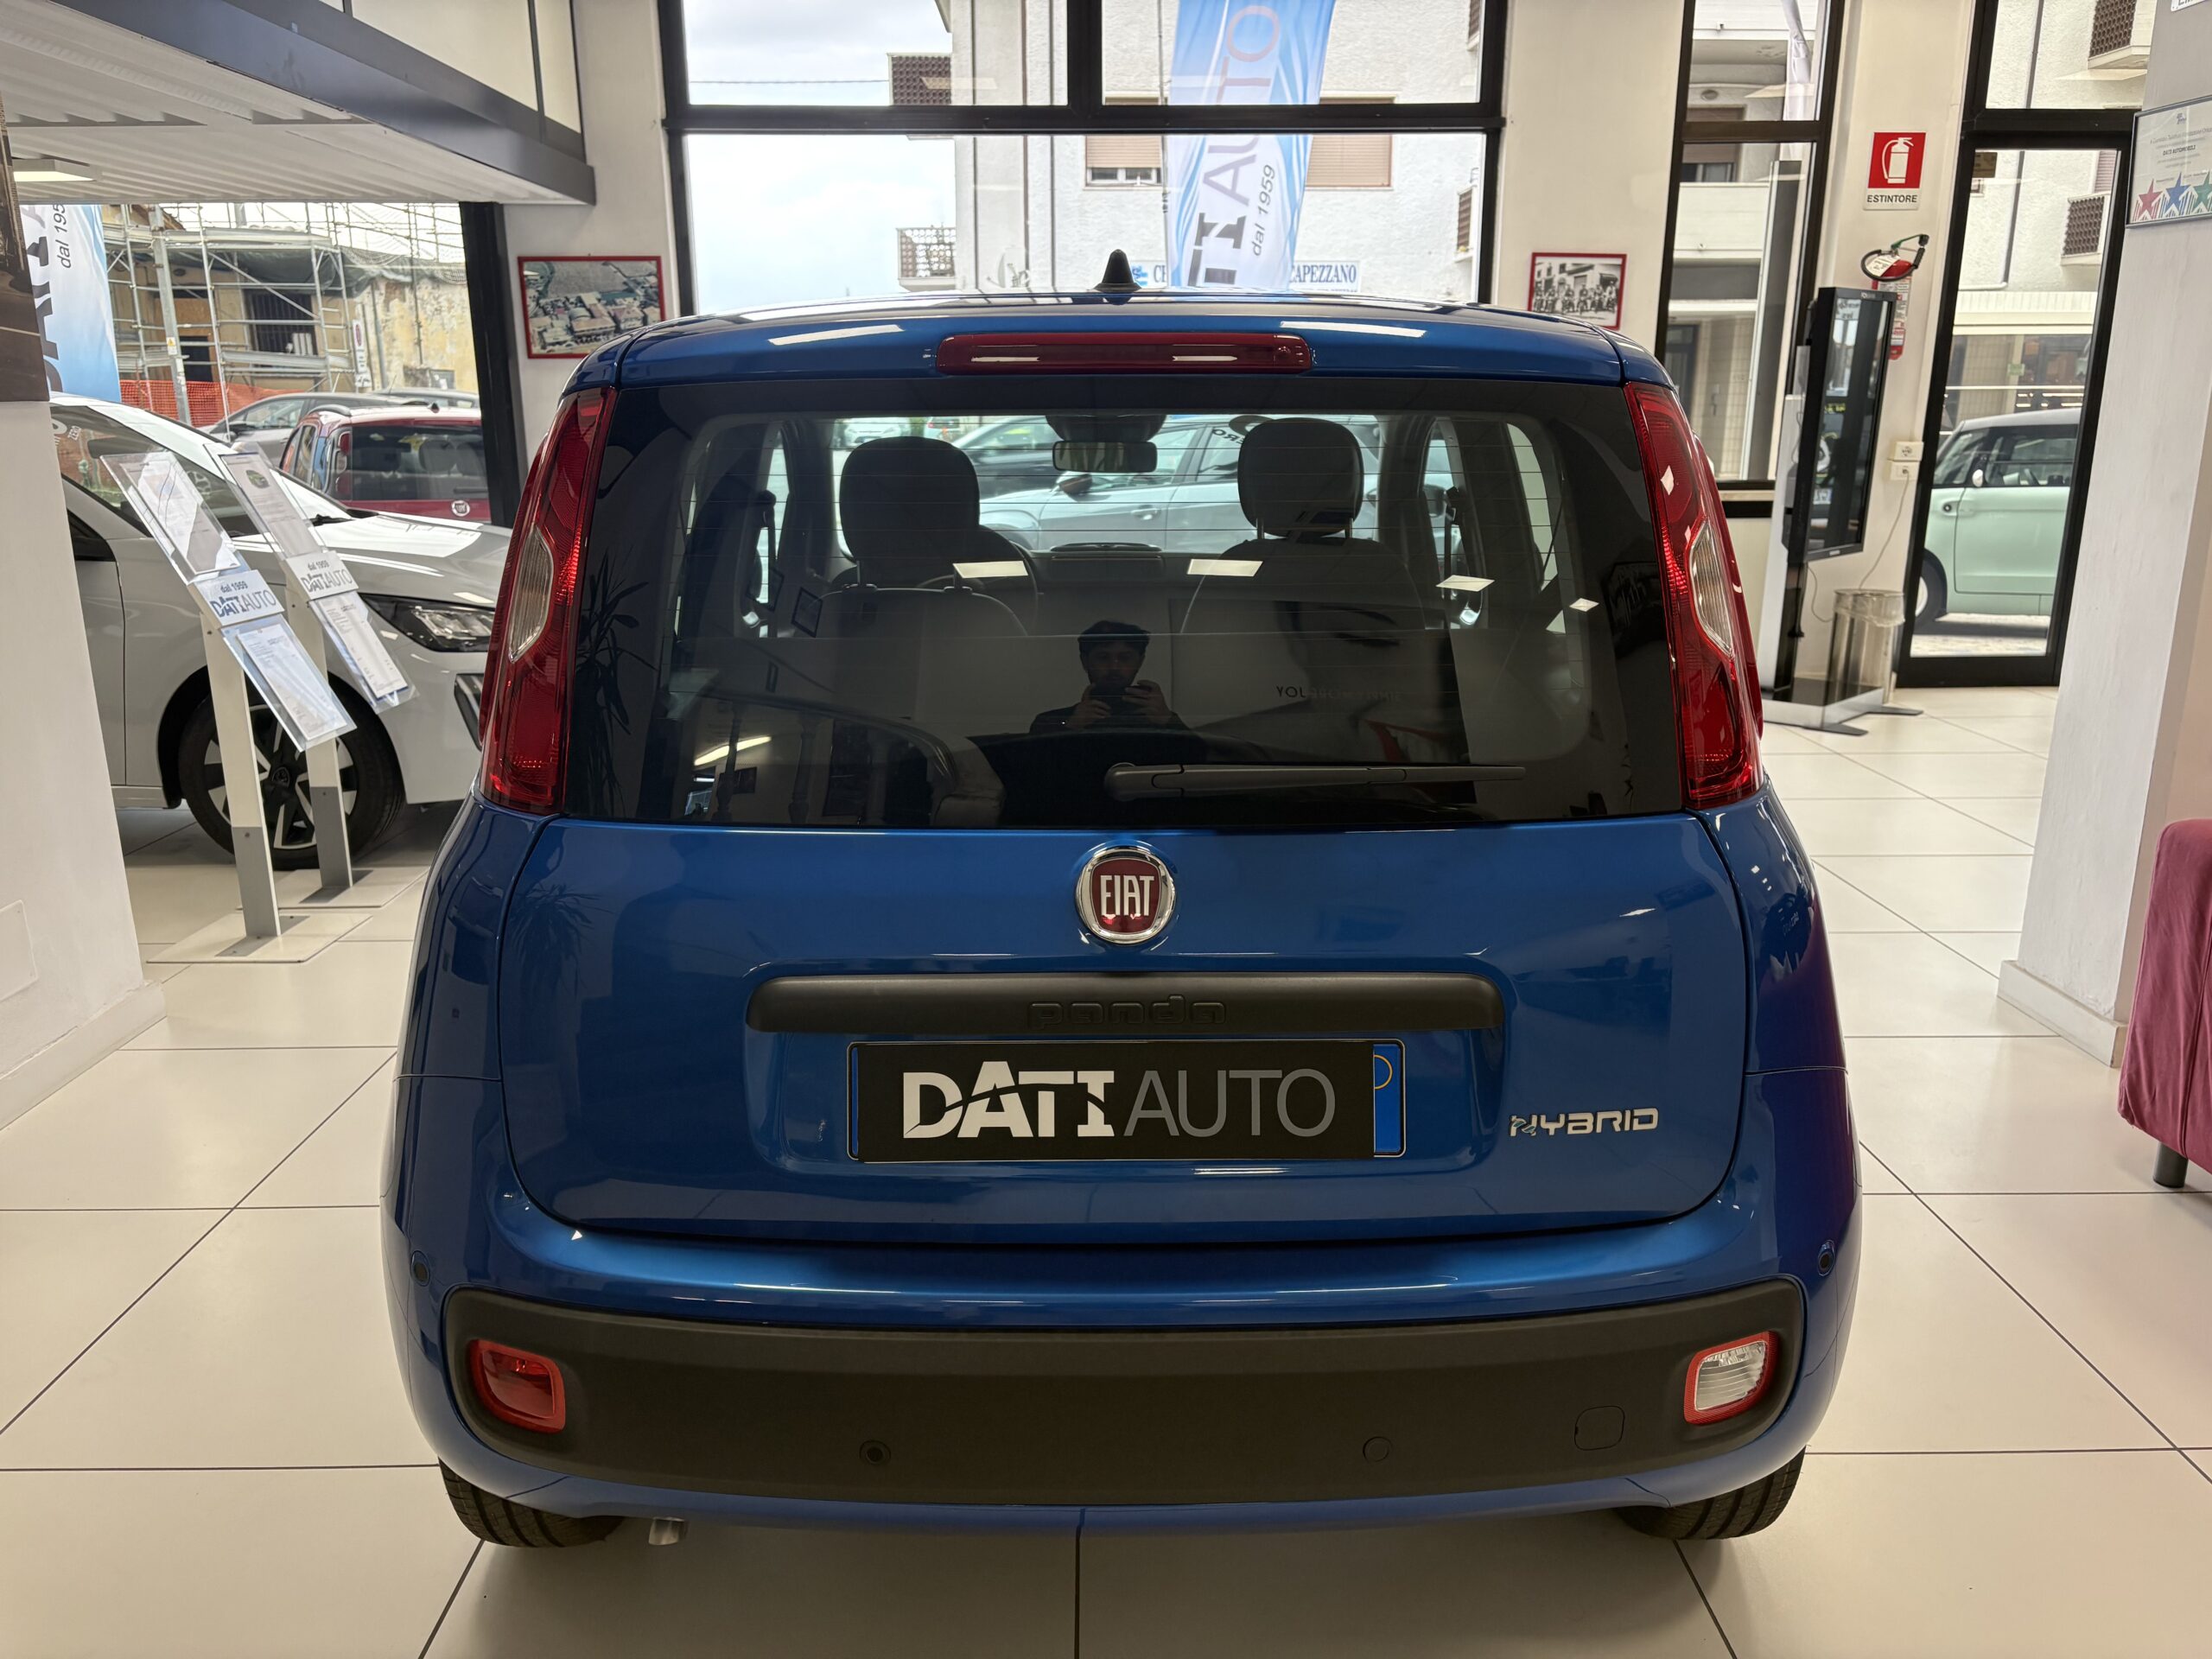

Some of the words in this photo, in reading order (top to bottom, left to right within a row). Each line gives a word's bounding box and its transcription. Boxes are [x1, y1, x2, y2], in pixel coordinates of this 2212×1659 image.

[1258, 164, 1275, 215] 1959
[1866, 194, 1918, 203] ESTINTORE
[52, 204, 68, 237] 195
[56, 239, 72, 269] dal
[1252, 223, 1265, 257] dal
[220, 582, 232, 594] dal
[232, 581, 248, 592] 1959
[1100, 874, 1155, 918] FIAT
[1028, 994, 1227, 1030] panda
[1510, 1107, 1659, 1137] HYBRID
